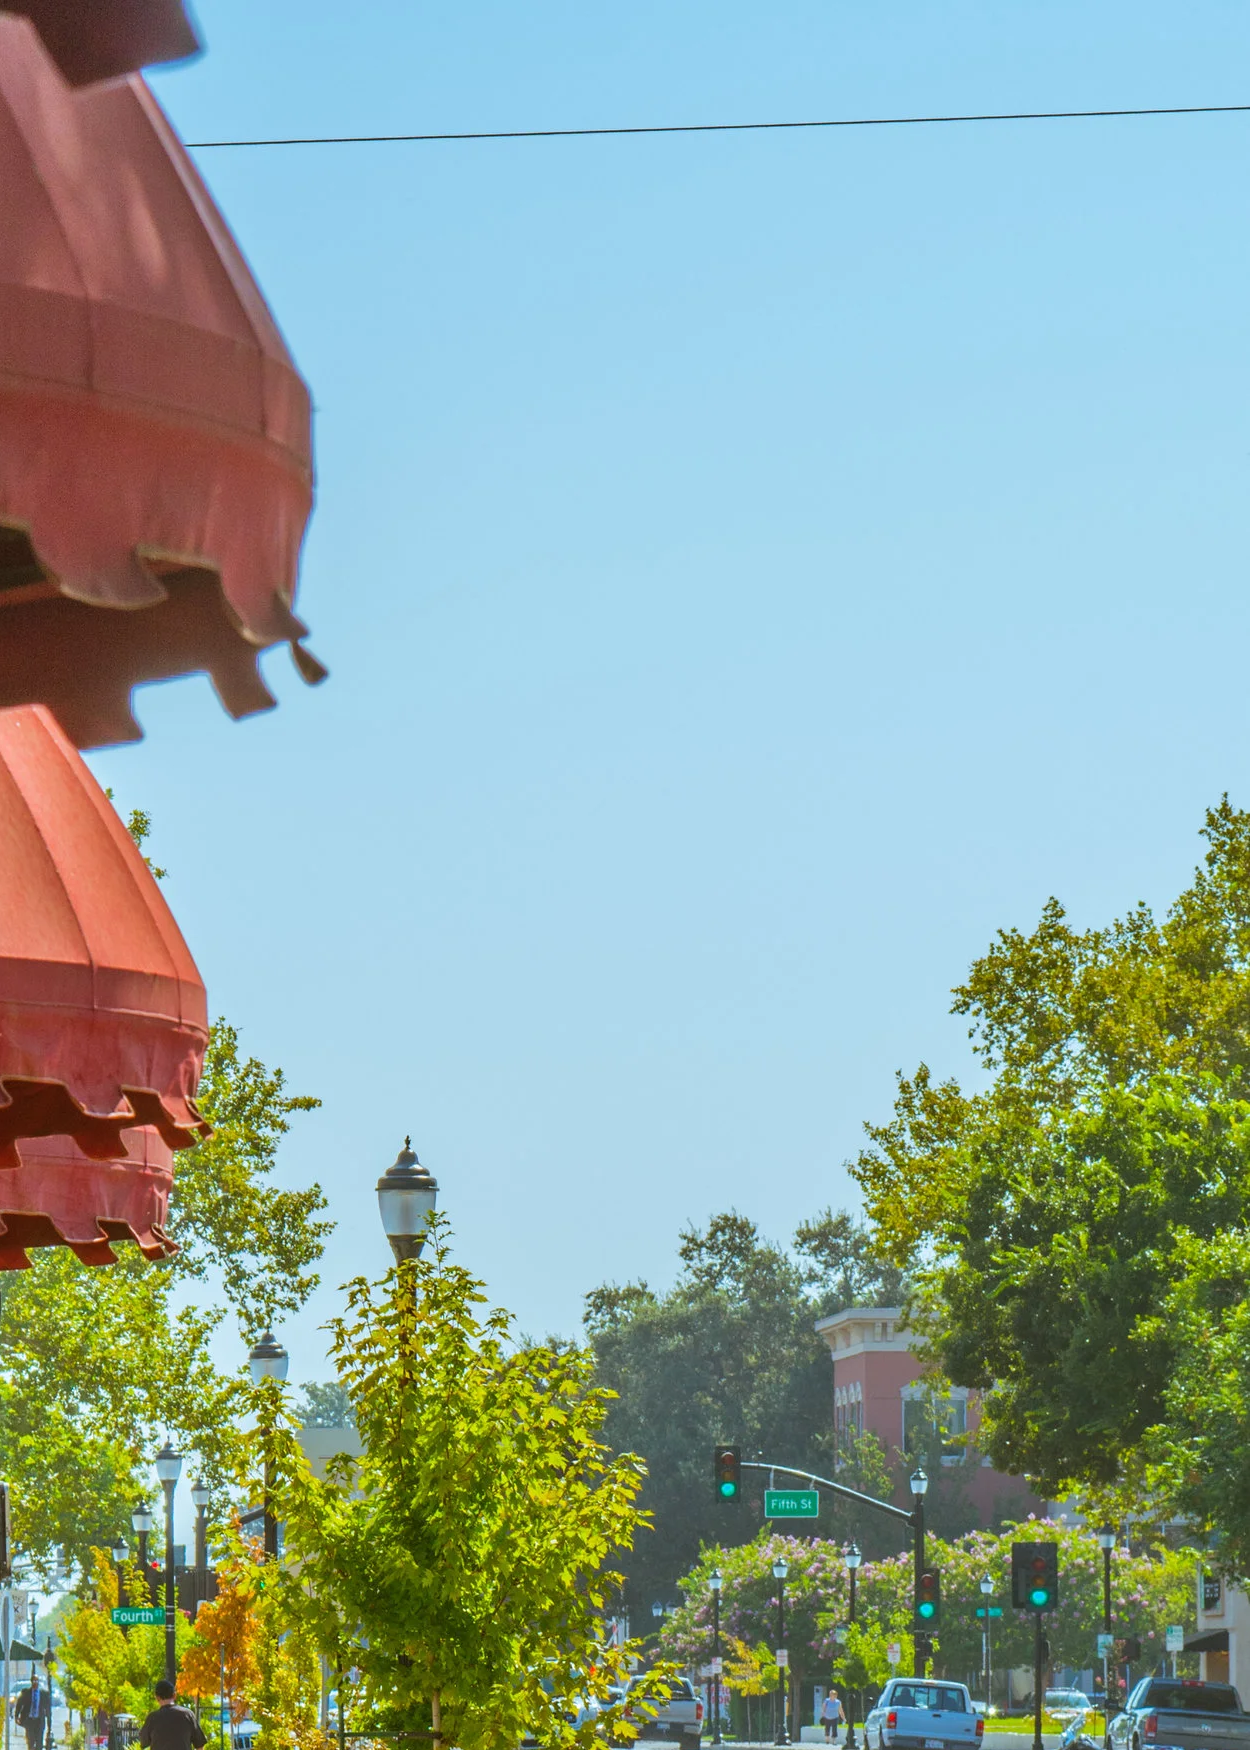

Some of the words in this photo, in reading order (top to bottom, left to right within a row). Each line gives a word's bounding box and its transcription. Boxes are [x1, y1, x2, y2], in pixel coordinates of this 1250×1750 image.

[771, 1499, 797, 1509] Fifth
[800, 1499, 812, 1509] St
[112, 1610, 154, 1622] Fourth
